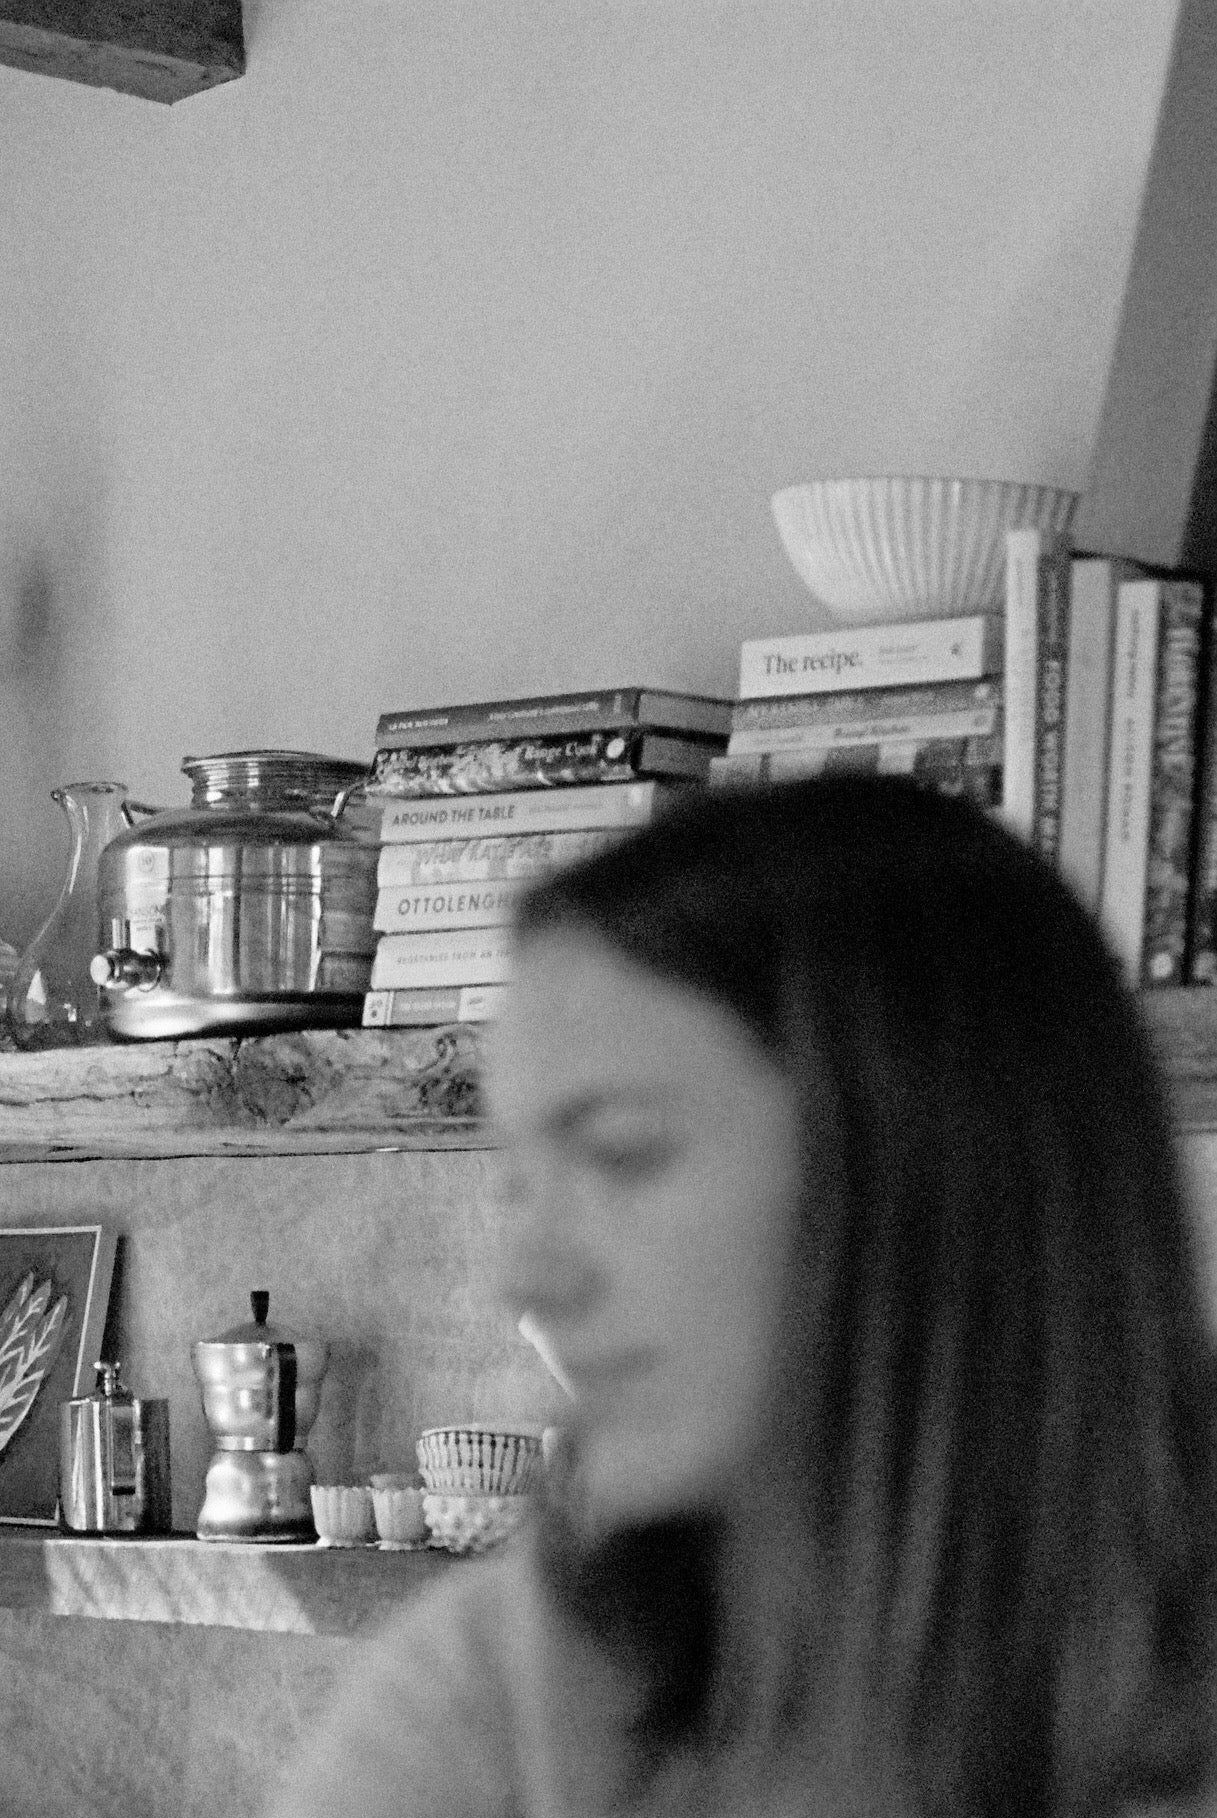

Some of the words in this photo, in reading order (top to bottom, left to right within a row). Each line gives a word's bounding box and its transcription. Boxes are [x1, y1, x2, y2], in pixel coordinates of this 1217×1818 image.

[763, 654, 798, 675] The
[802, 648, 863, 674] recipe.
[392, 810, 447, 827] AROUND
[452, 808, 474, 822] THE
[478, 804, 516, 821] TABLE
